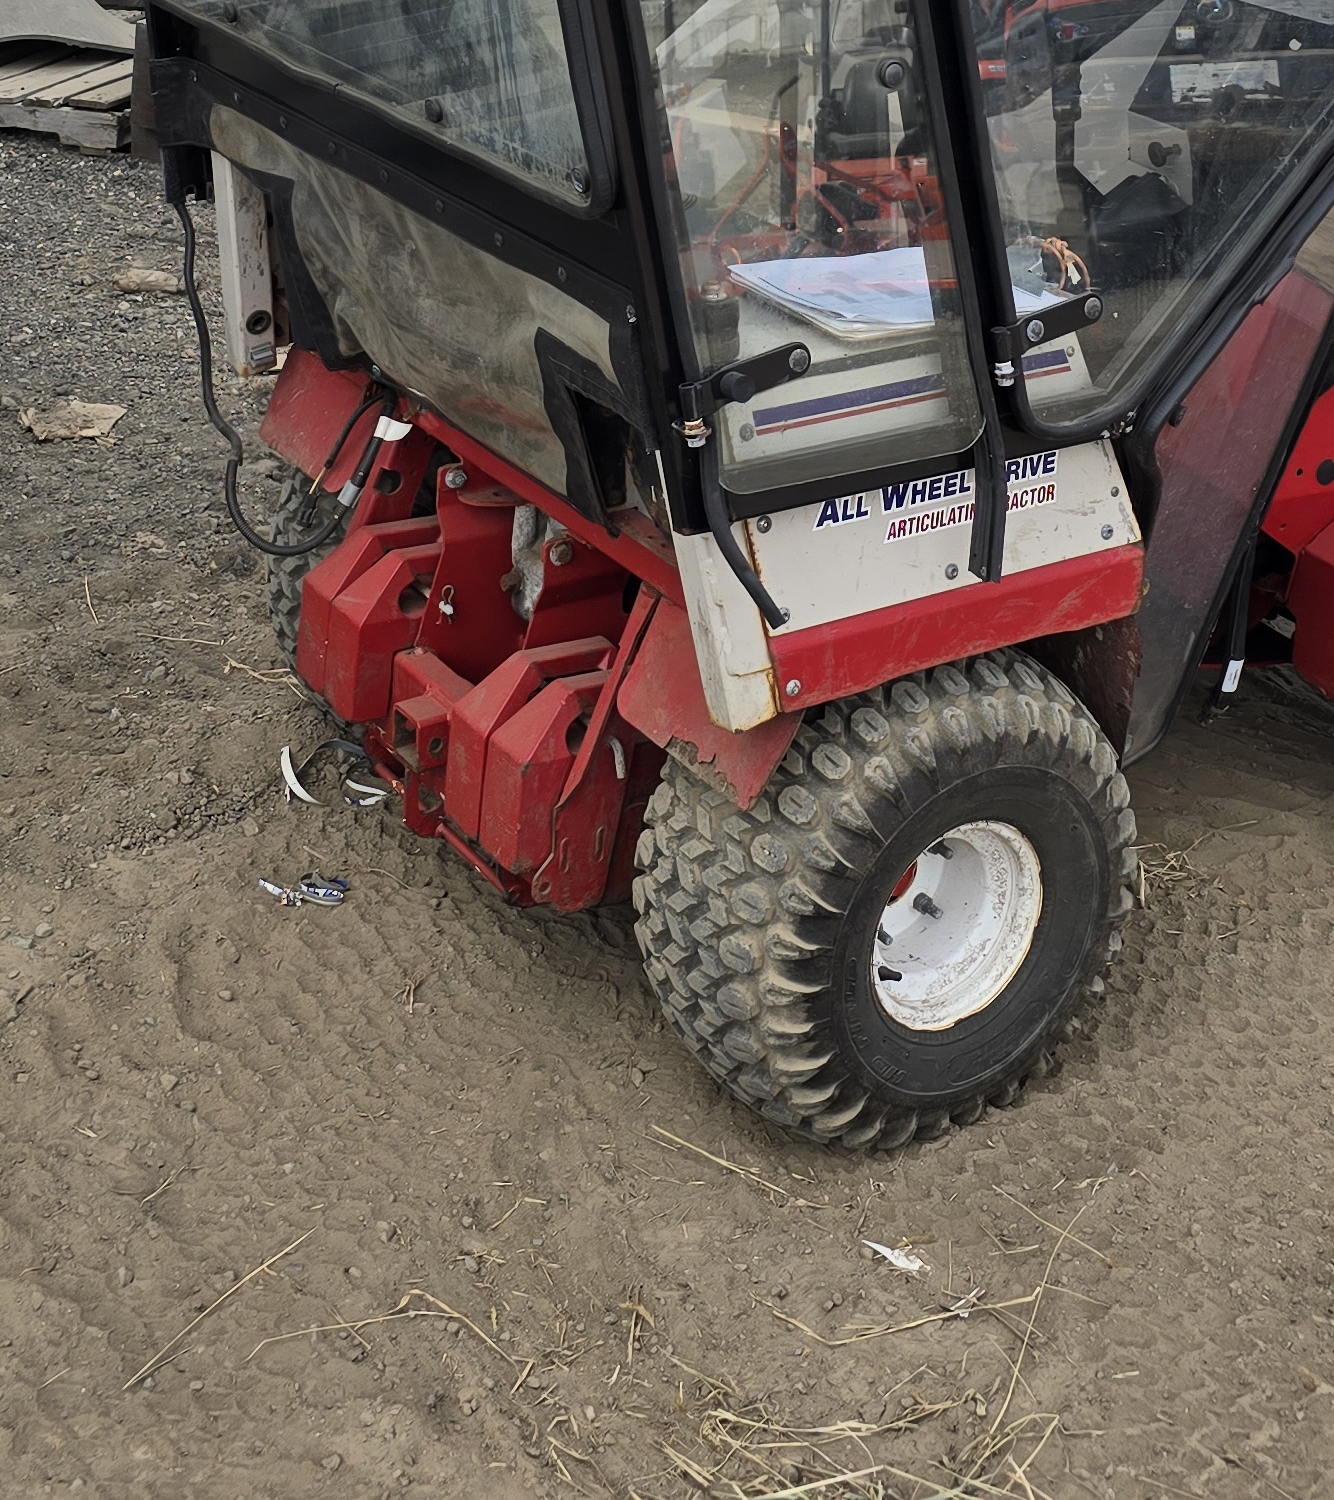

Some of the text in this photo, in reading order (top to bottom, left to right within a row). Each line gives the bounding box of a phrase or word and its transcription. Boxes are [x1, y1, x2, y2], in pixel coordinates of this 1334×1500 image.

[816, 452, 1056, 528] ALL WHEEL RIVE
[887, 484, 1055, 541] ARTICULATIN ACTOR
